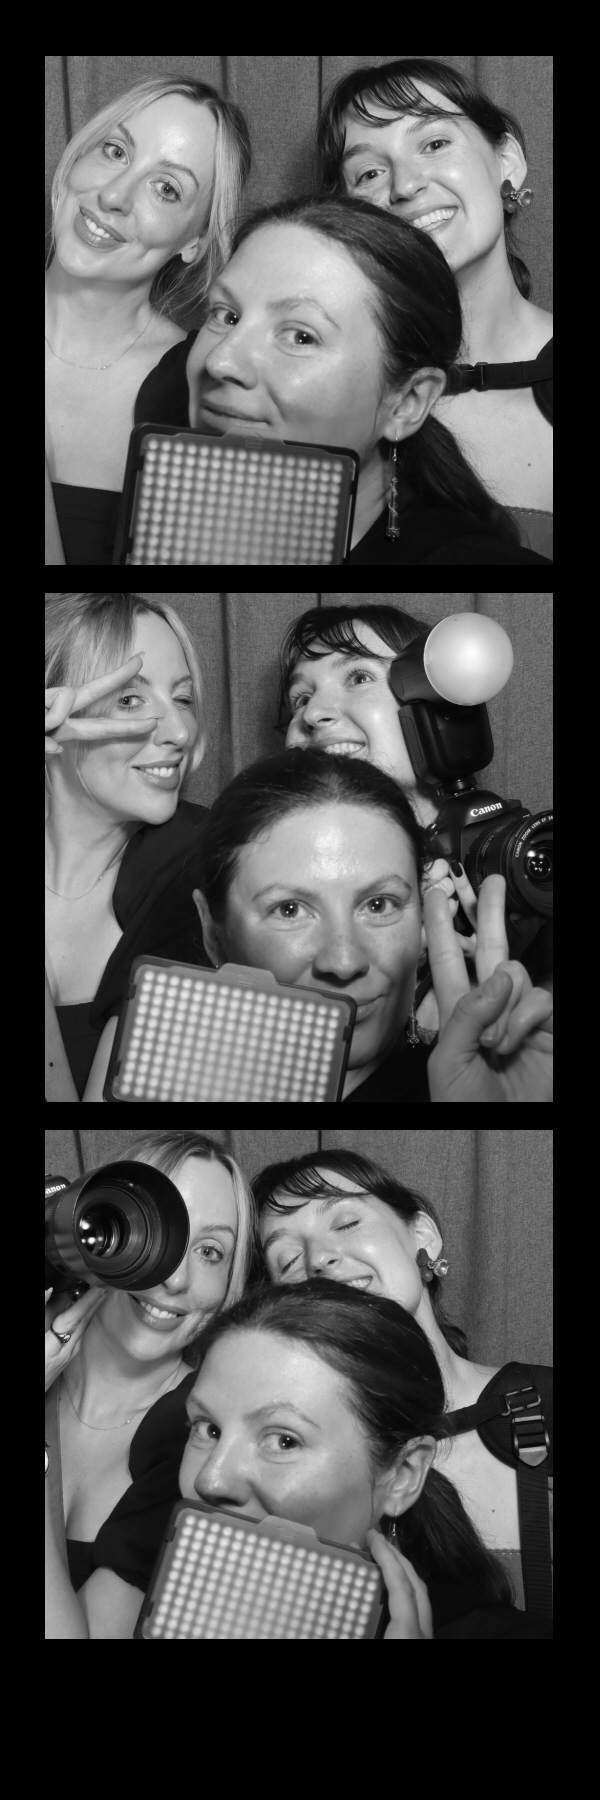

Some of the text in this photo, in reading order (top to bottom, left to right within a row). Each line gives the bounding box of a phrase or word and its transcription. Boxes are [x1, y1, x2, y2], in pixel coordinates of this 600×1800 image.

[470, 802, 503, 816] Canon
[515, 841, 523, 858] CANON
[521, 828, 531, 841] ZOOM
[531, 820, 541, 829] LENS
[45, 1183, 66, 1195] anon
